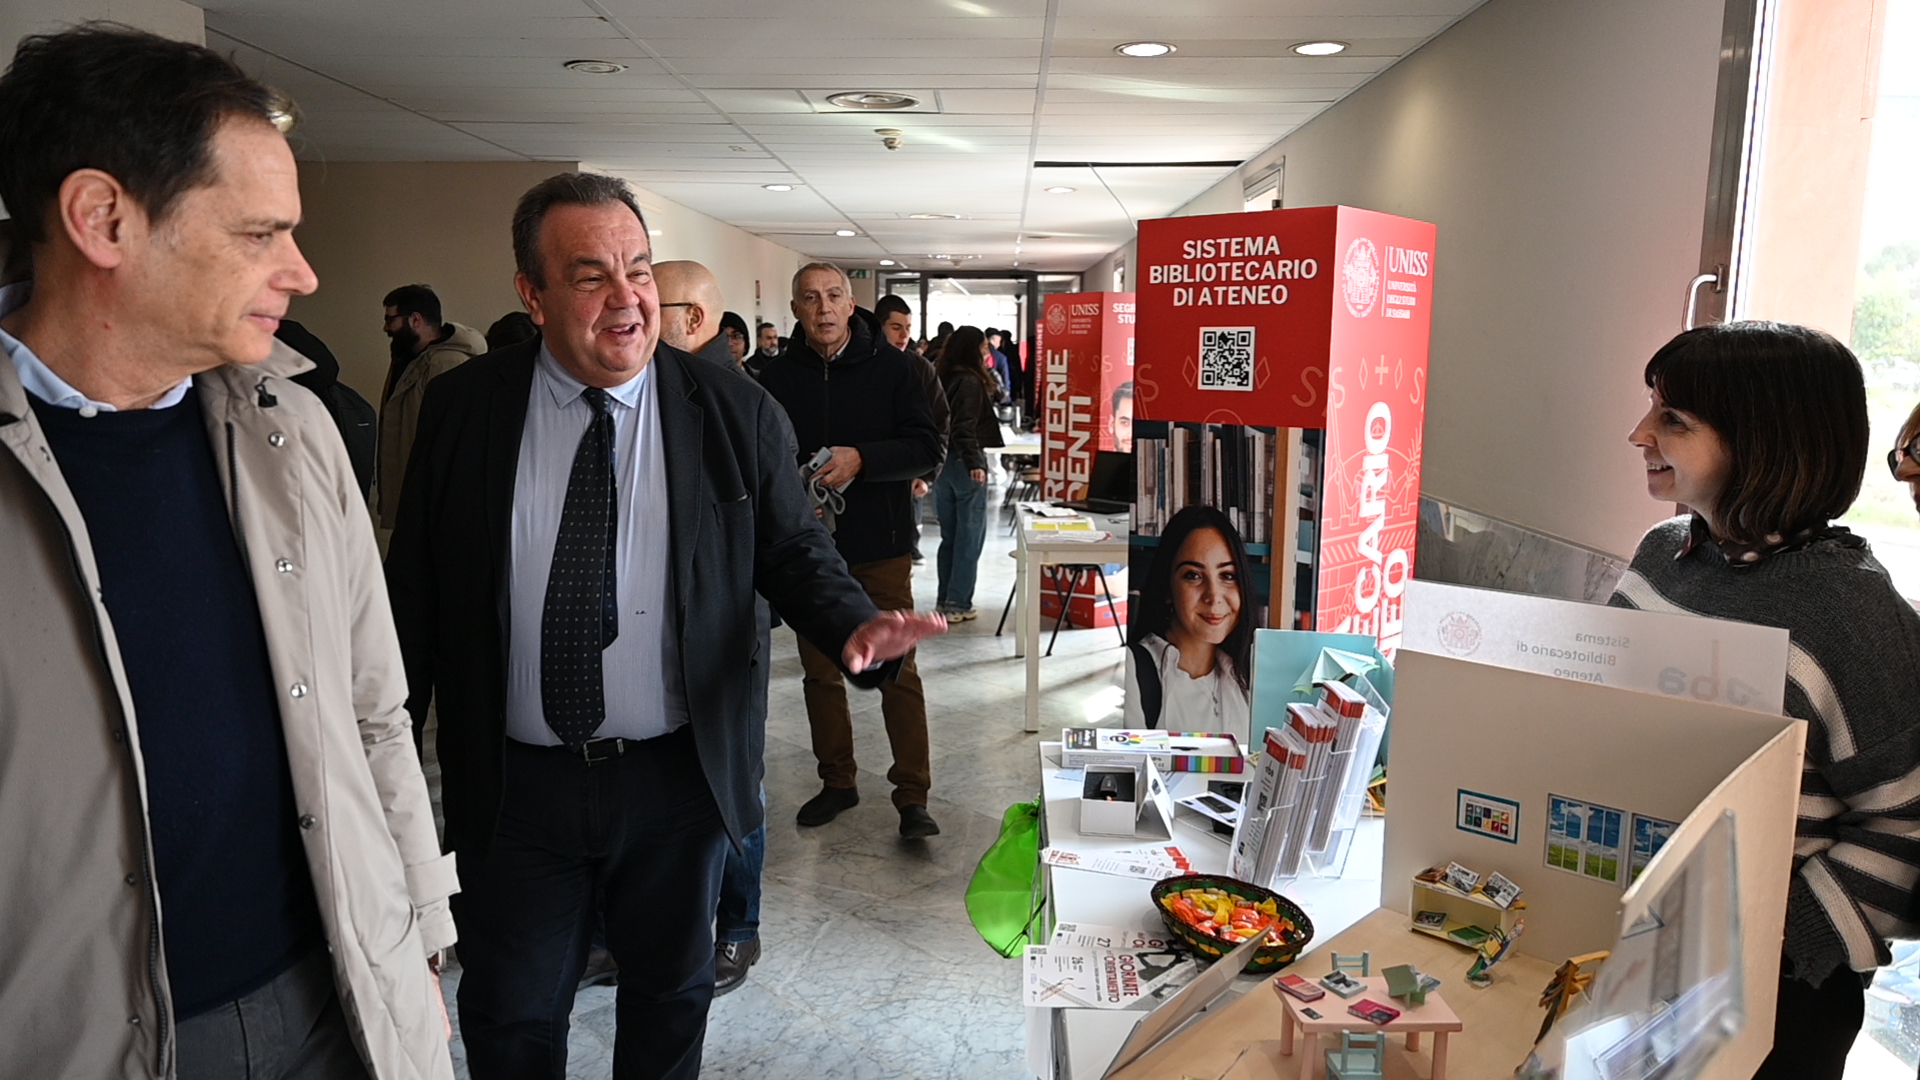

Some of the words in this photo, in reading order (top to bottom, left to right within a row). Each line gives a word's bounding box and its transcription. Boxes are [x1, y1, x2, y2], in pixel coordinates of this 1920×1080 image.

[1182, 235, 1281, 260] SISTEMA
[1149, 258, 1318, 285] BIBLIOTECARIO
[1388, 246, 1428, 276] UNISS
[1173, 287, 1194, 307] DI
[1197, 284, 1289, 307] ATENEO
[1071, 303, 1100, 316] UNISS
[1097, 936, 1111, 948] 27
[1118, 954, 1140, 997] GIORNATE
